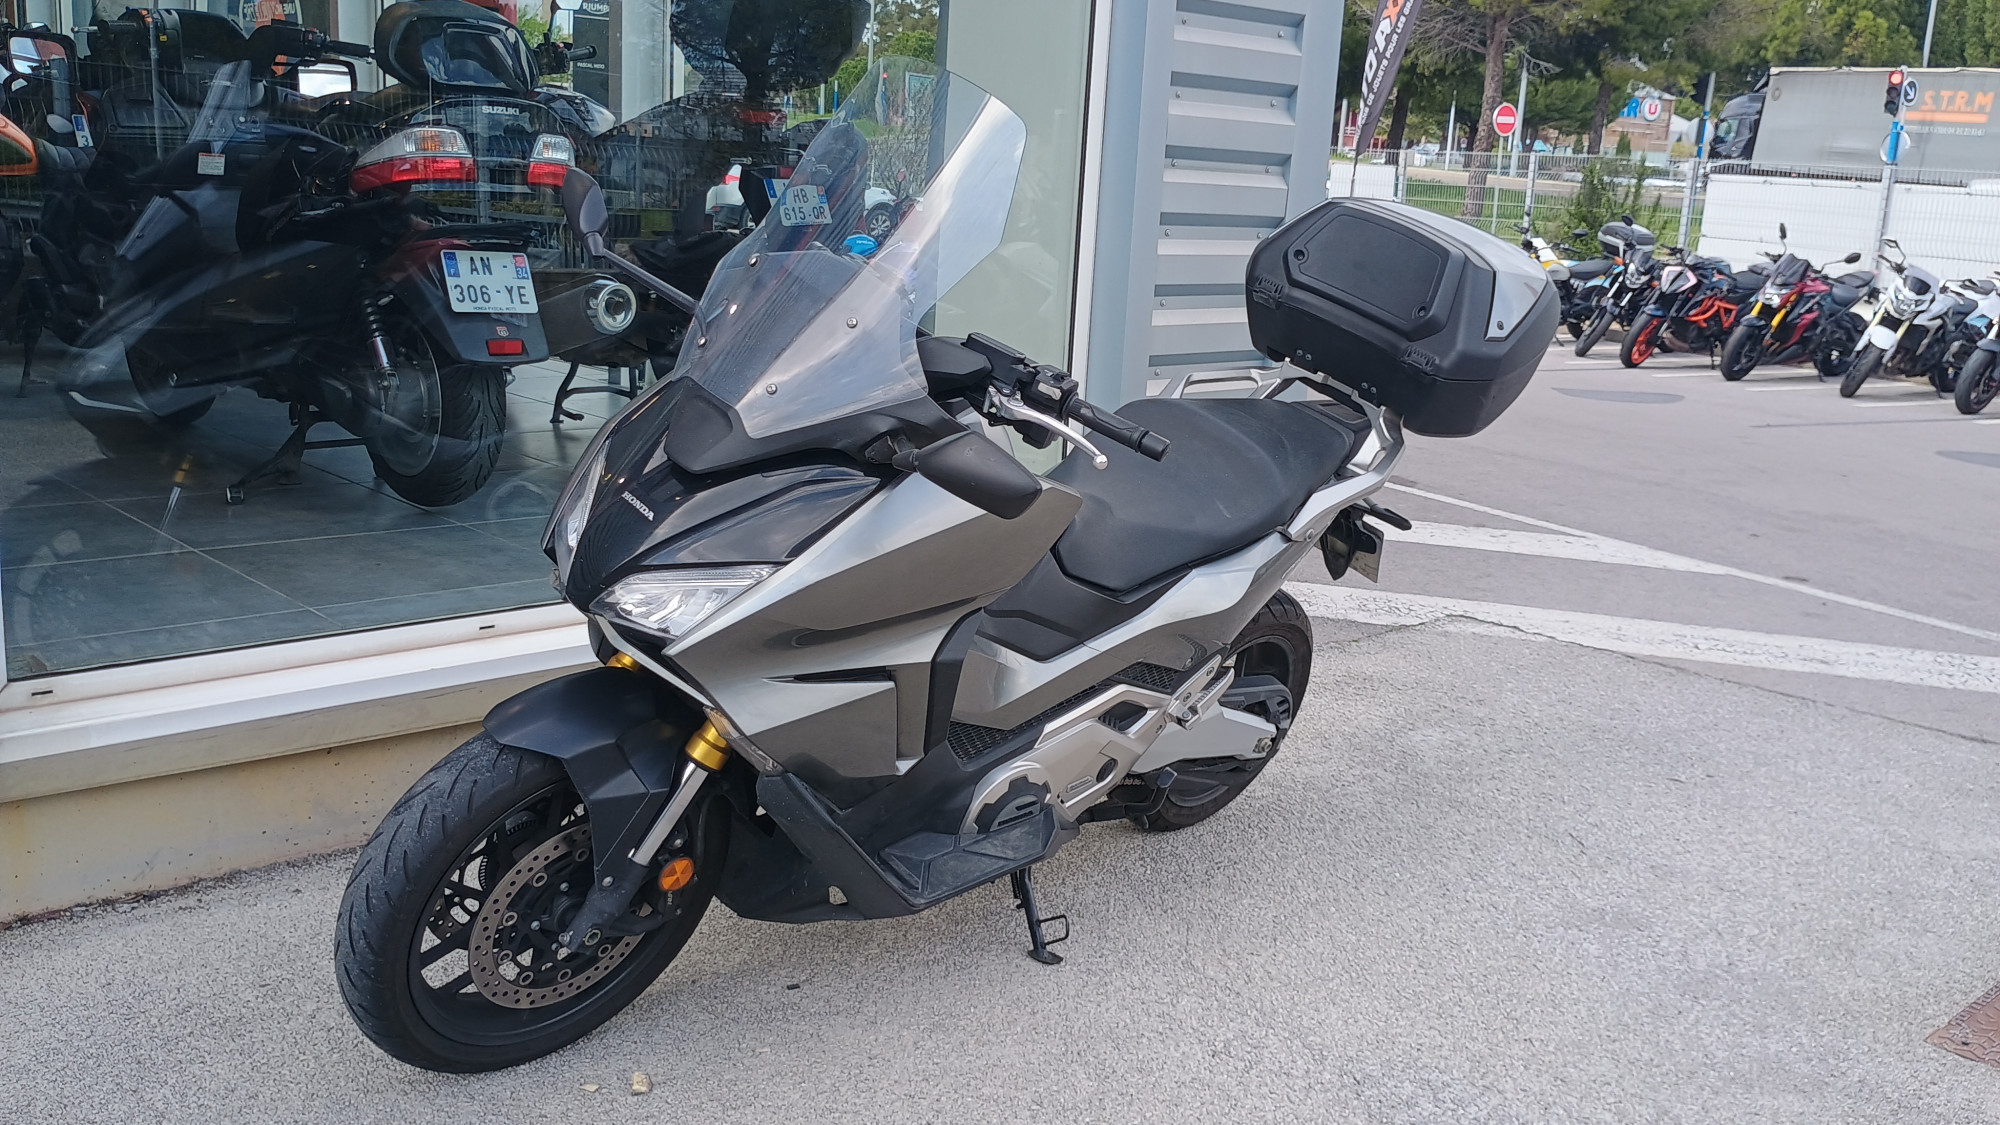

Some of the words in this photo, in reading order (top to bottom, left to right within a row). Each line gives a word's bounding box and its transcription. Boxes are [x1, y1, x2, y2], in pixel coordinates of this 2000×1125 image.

[582, 2, 610, 11] RIUMP
[1372, 58, 1389, 93] JOUETS
[1385, 33, 1399, 59] POUR
[1395, 15, 1406, 34] LES
[481, 105, 520, 116] SUZUKI
[1648, 103, 1659, 115] U
[517, 268, 528, 278] 34
[621, 490, 655, 521] HONDA
